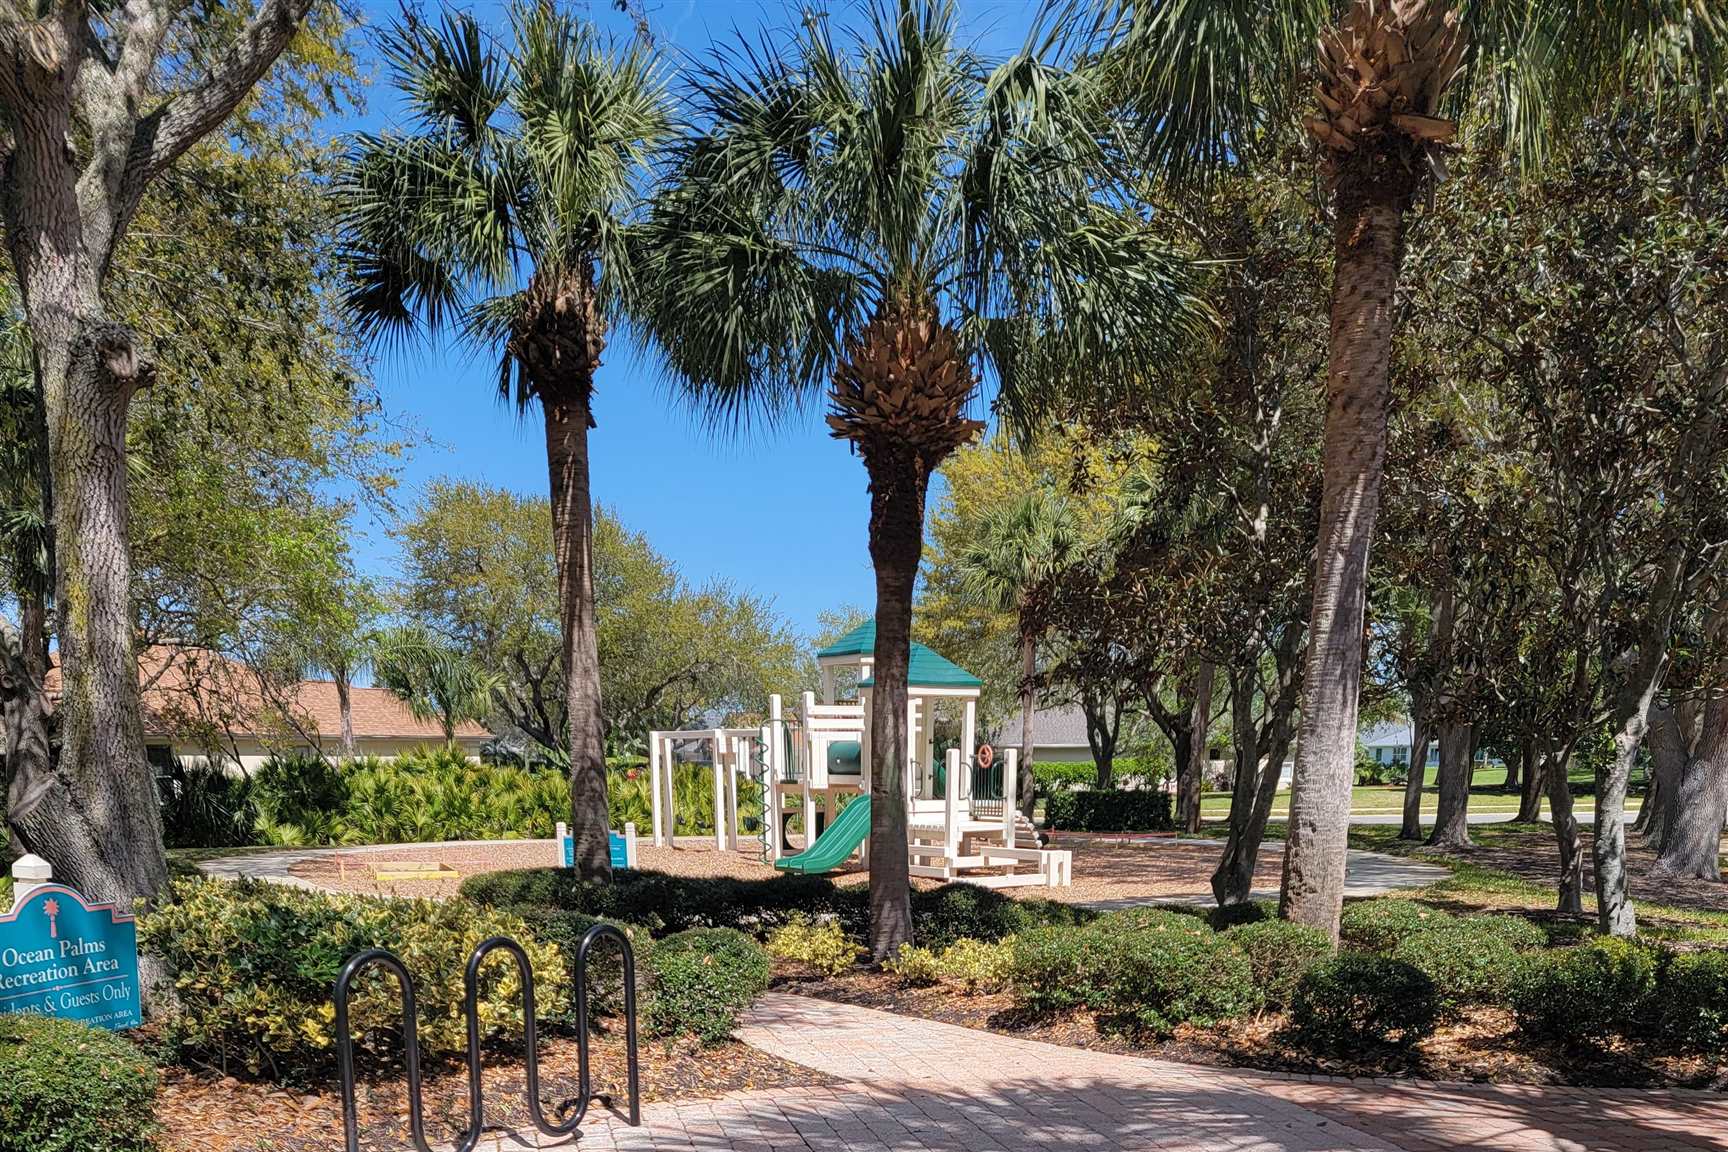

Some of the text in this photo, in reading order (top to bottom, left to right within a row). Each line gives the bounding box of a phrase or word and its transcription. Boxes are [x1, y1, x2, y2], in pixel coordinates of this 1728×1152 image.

[2, 937, 106, 967] Ocean Palms
[83, 957, 119, 975] Area
[43, 995, 57, 1013] &
[60, 992, 100, 1009] Guests
[102, 982, 131, 1000] Only
